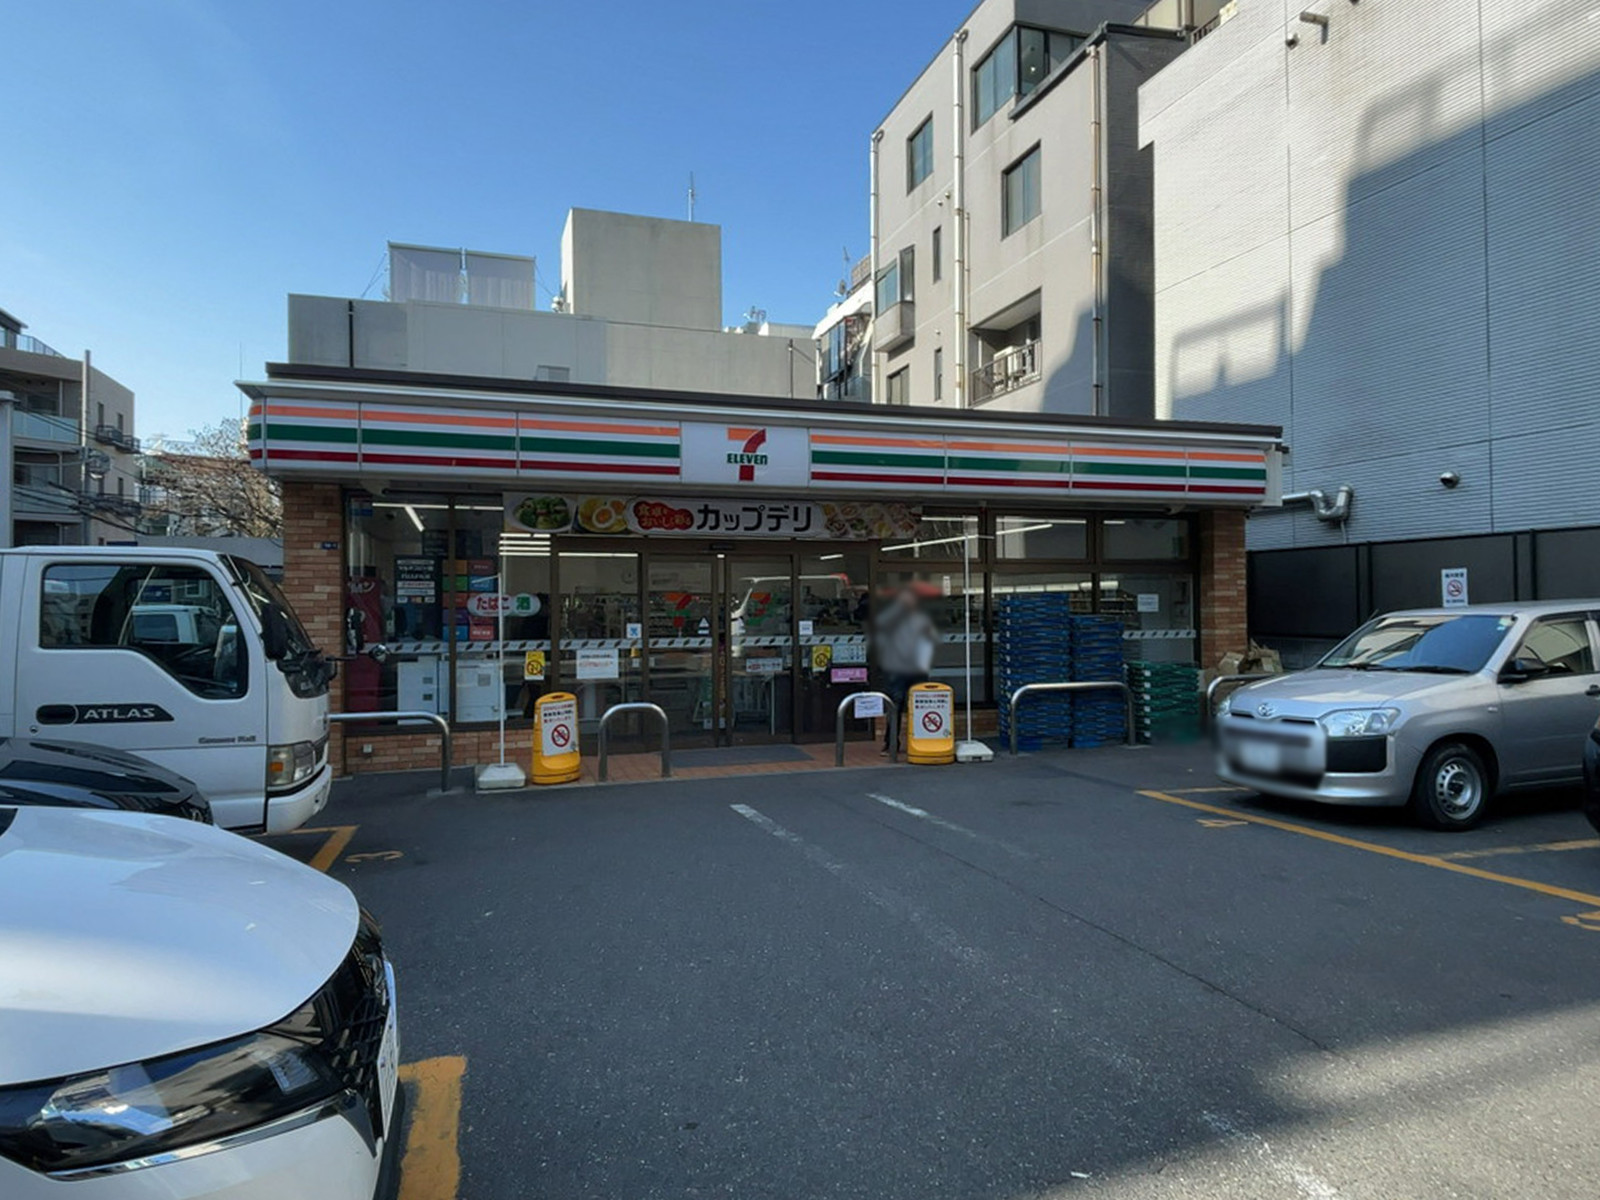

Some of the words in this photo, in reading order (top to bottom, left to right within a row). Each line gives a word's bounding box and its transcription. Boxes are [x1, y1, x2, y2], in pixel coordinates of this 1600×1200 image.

[727, 427, 766, 481] 7
[696, 504, 812, 532] カップデリ
[476, 596, 510, 611] たばこ
[516, 596, 531, 611] 酒
[83, 707, 156, 719] ATLAS
